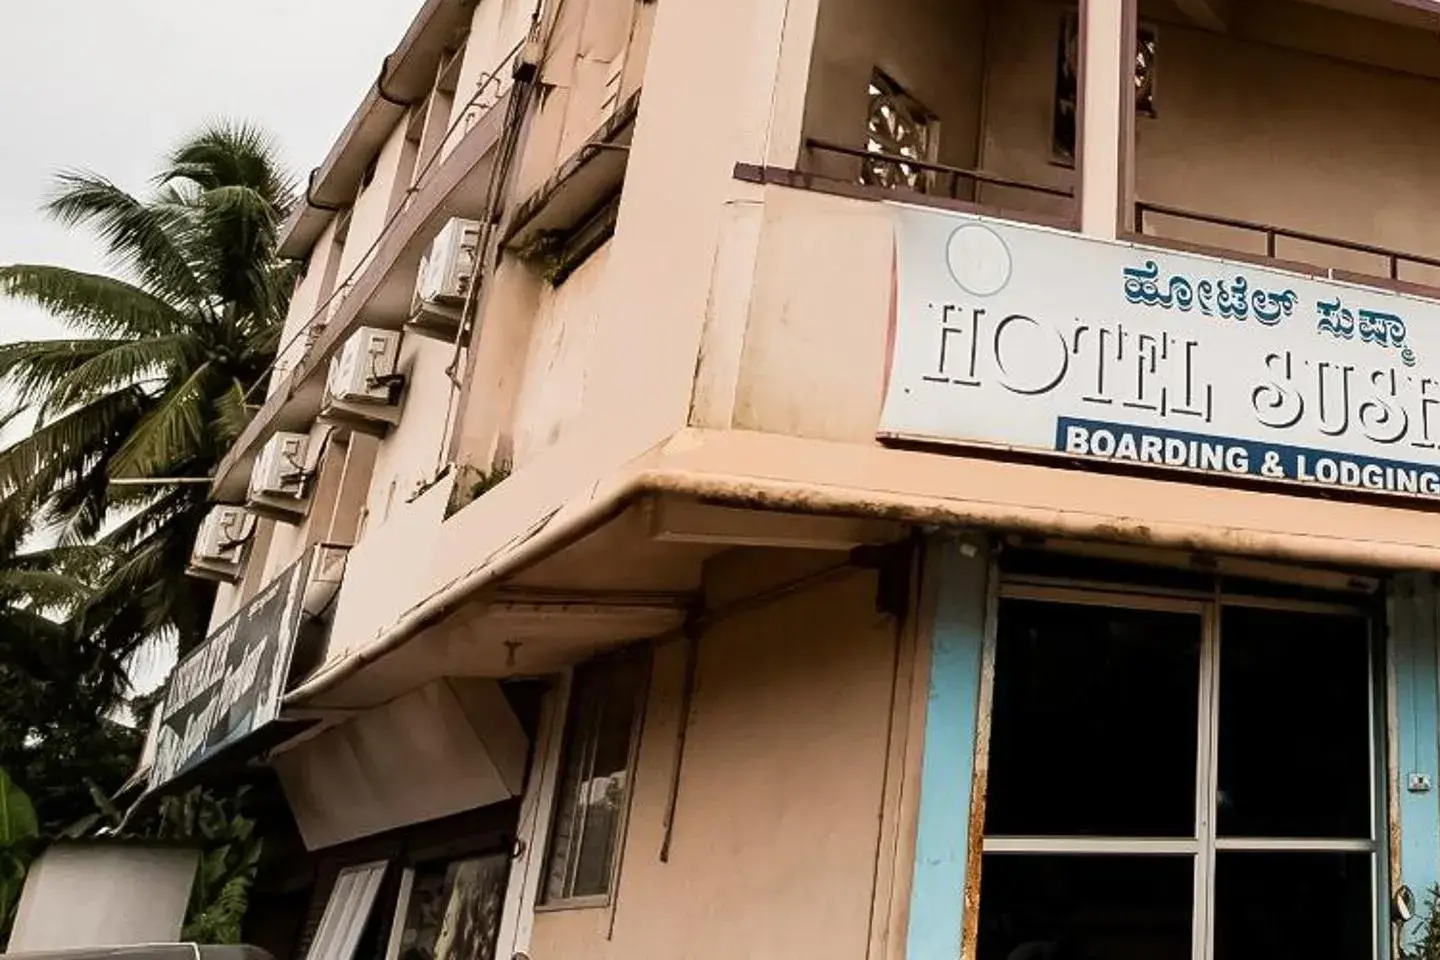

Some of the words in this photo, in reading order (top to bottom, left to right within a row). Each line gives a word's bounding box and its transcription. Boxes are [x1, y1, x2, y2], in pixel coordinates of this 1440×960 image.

[922, 303, 1212, 423] HOTEL
[1122, 260, 1298, 325] ಹೋಟೆಲ್
[1316, 297, 1416, 367] ಸುಷ್ಮಾ
[1065, 425, 1250, 474] BOARDING
[1260, 450, 1285, 478] &
[1296, 454, 1440, 495] LODGING
